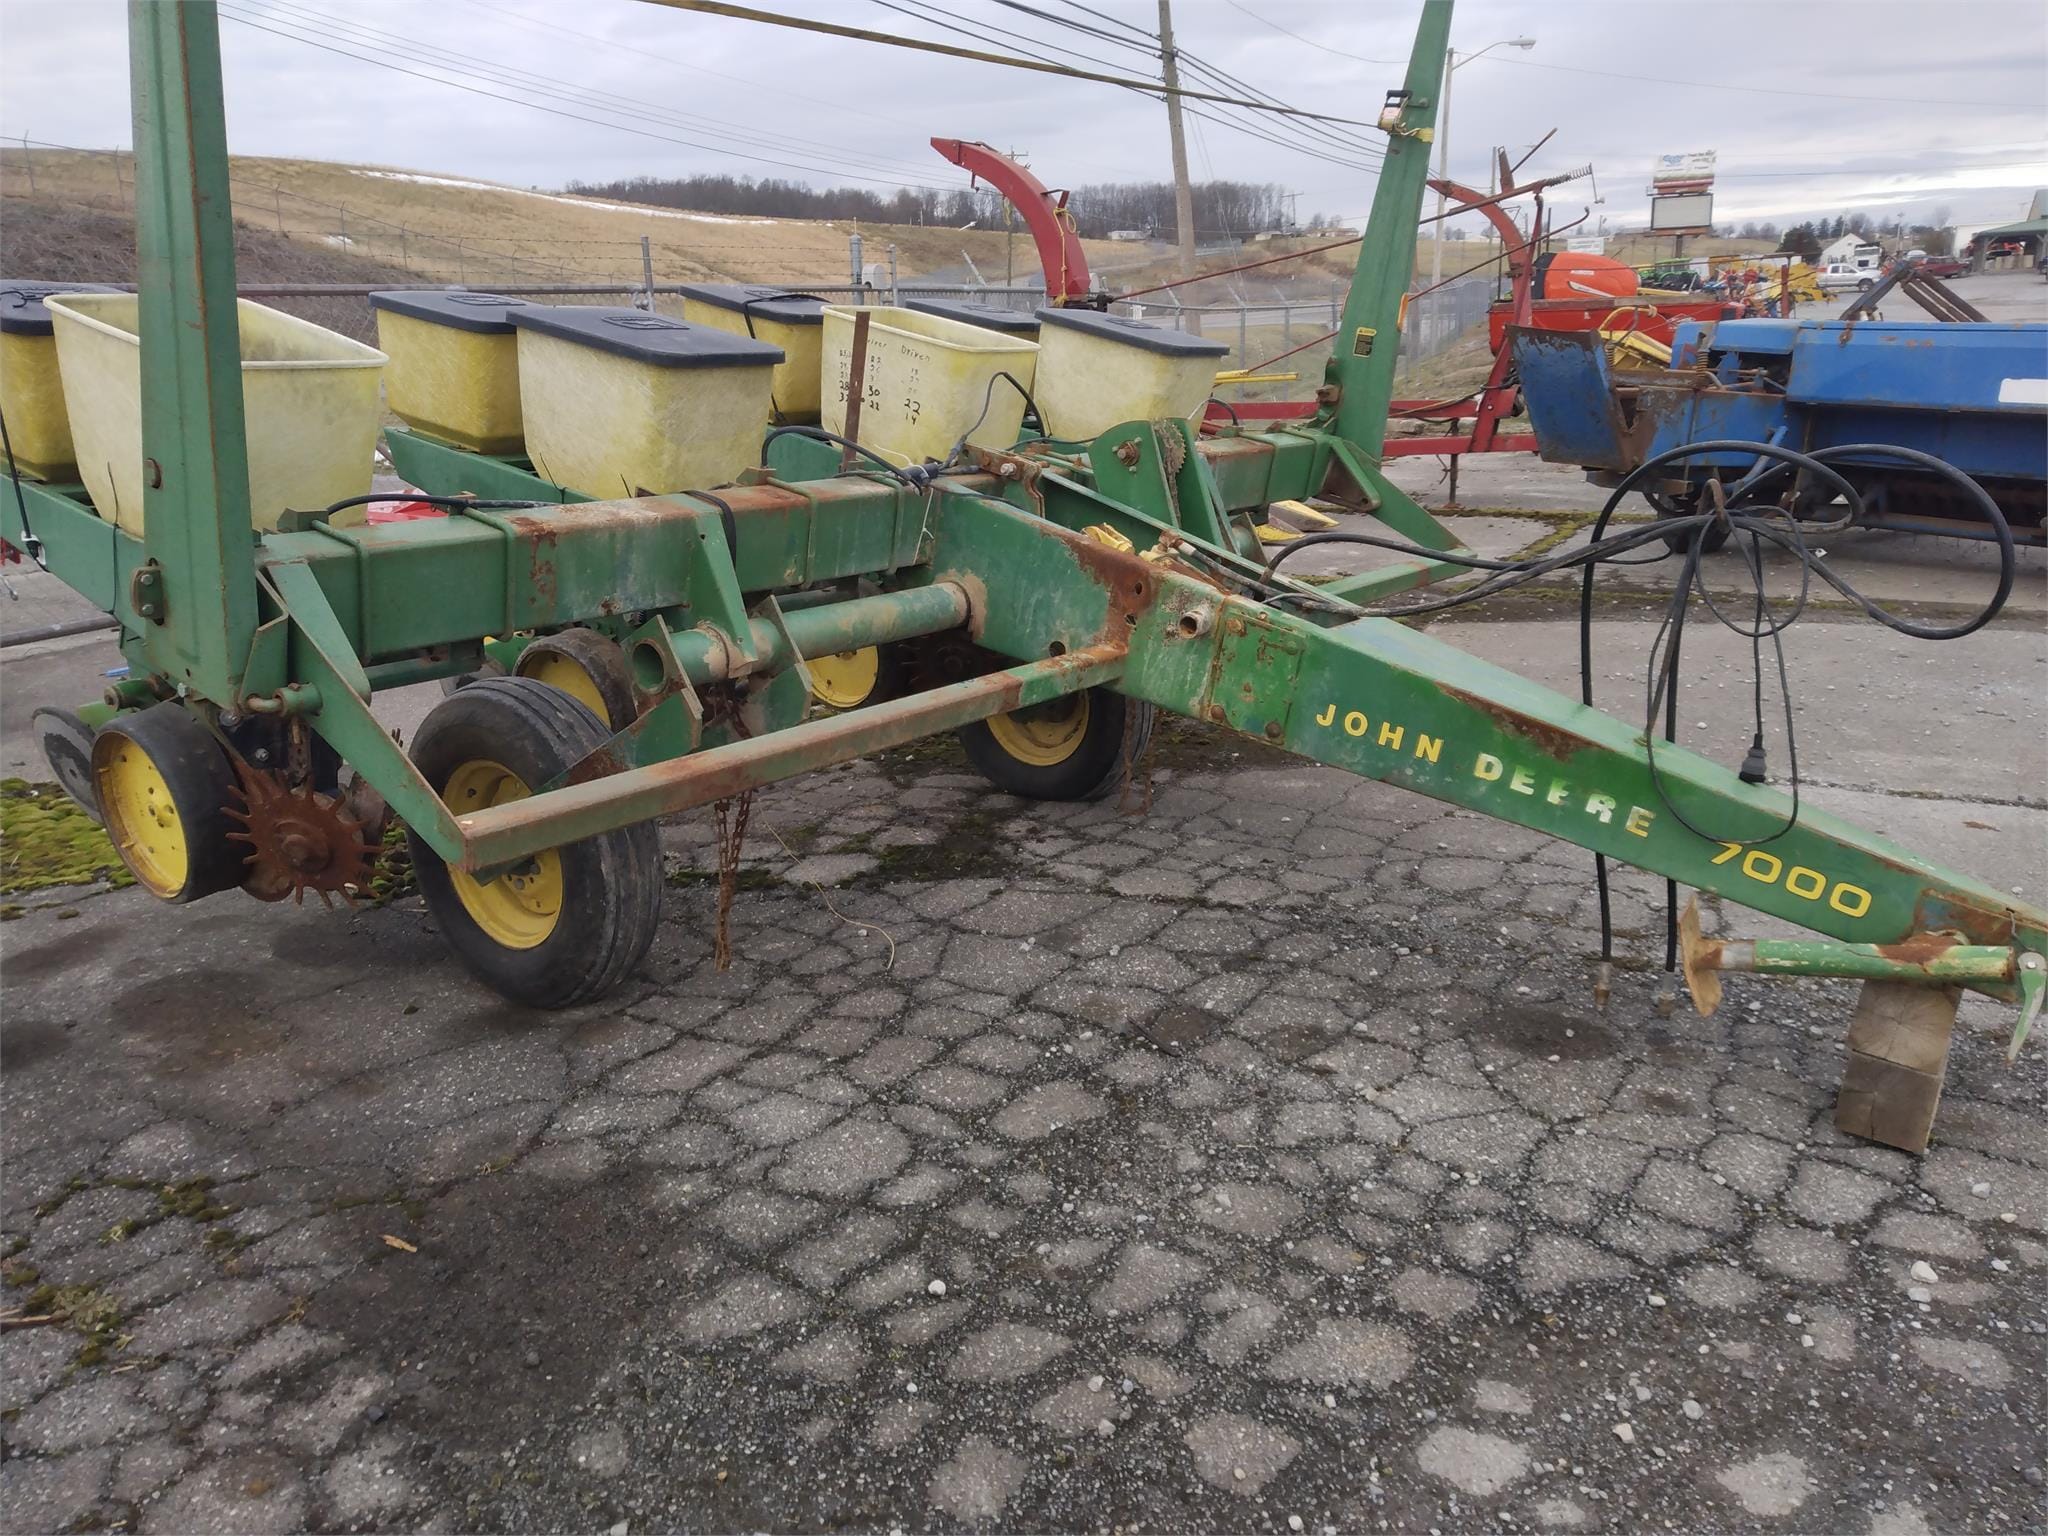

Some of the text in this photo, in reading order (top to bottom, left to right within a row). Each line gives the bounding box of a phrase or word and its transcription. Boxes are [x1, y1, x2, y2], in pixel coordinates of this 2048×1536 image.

[868, 385, 881, 397] 30
[869, 400, 880, 411] 22
[904, 398, 921, 416] 22
[905, 412, 917, 425] 14
[1316, 703, 1657, 839] JOHN DEERE
[1710, 841, 1873, 919] 7000
